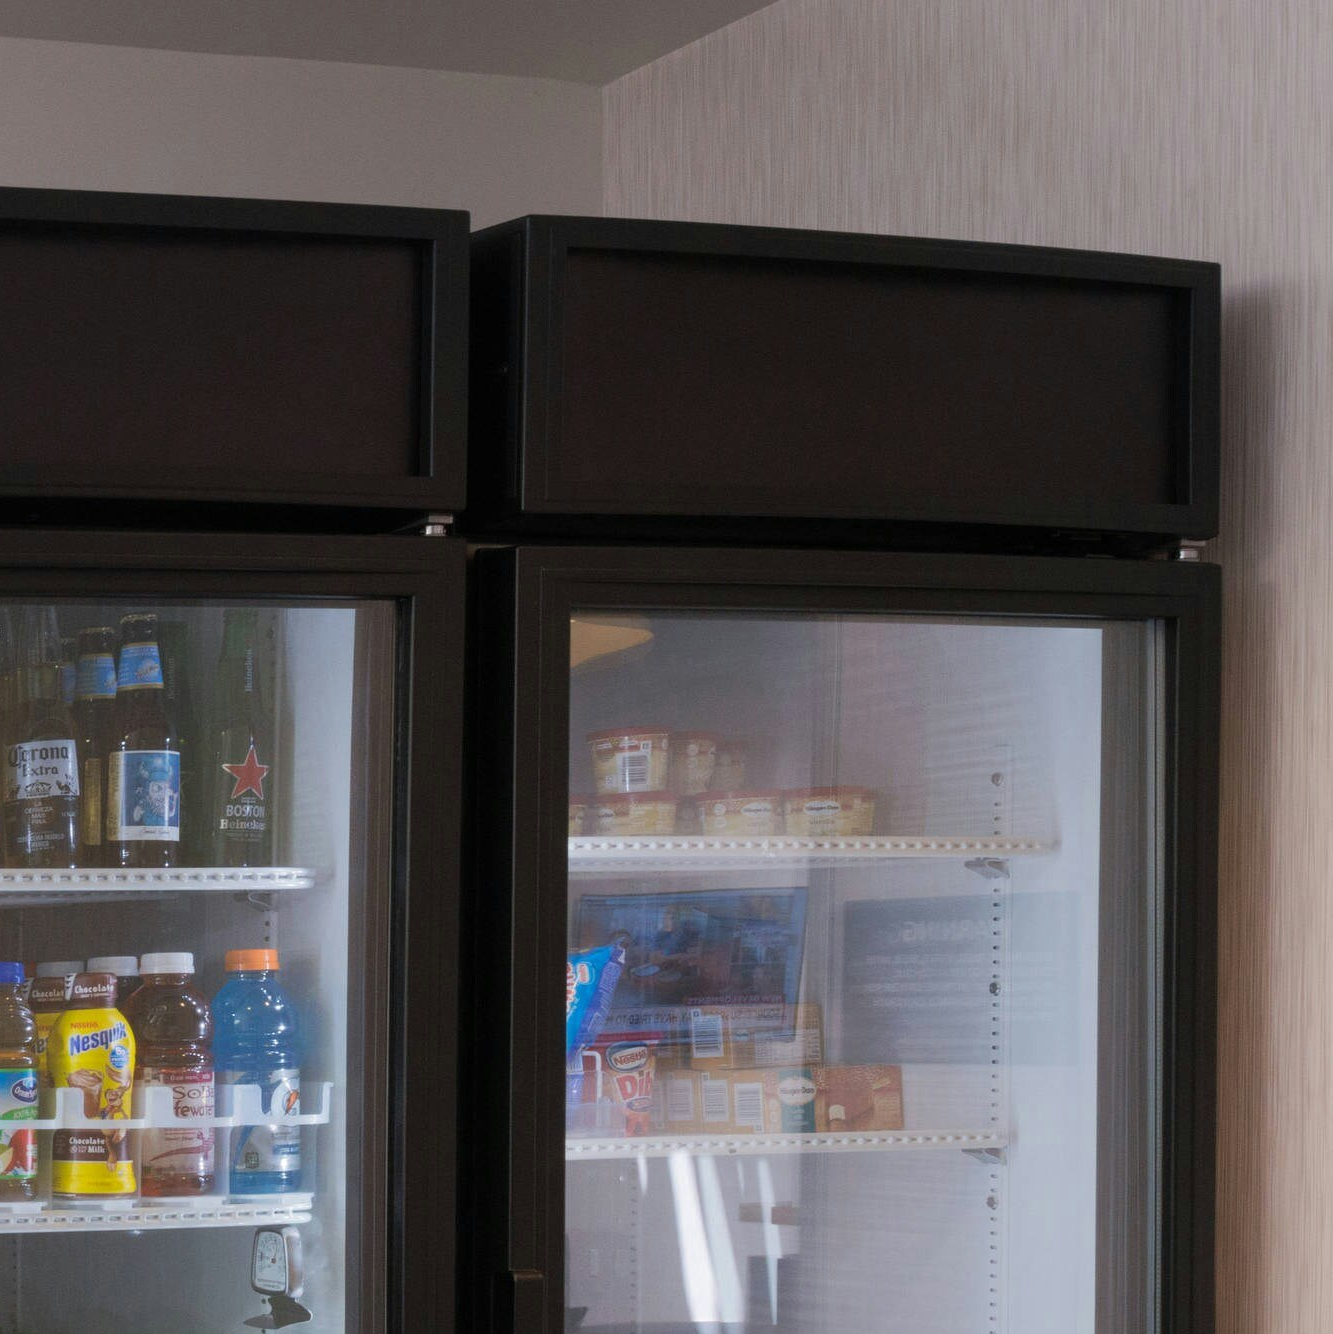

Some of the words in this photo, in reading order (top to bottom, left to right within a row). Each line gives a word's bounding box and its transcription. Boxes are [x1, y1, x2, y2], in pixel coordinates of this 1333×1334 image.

[7, 745, 70, 767] Corona
[22, 764, 59, 778] Extra
[226, 804, 266, 818] BOSTON
[73, 983, 115, 995] Chocolate
[69, 1023, 128, 1057] Nesquik
[613, 1046, 648, 1065] Nestlé
[68, 1136, 105, 1146] Chocolate
[88, 1145, 106, 1154] Milk
